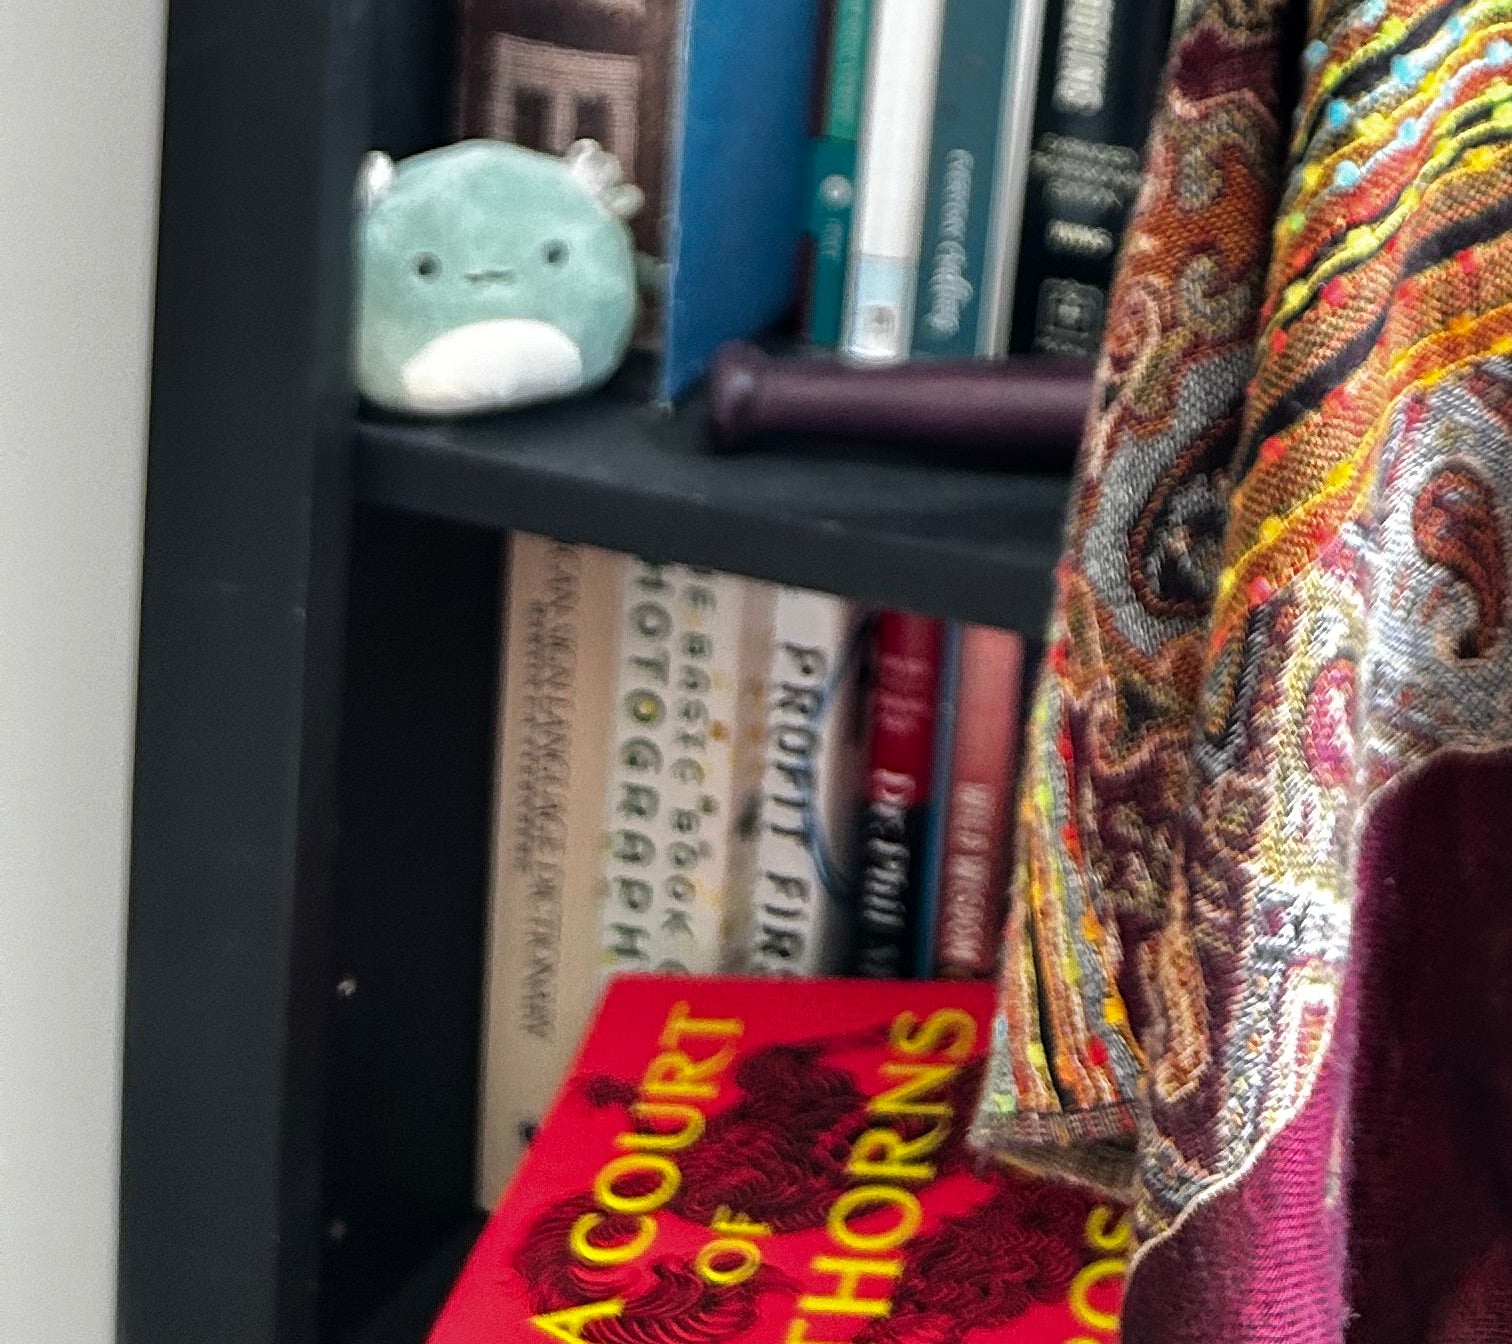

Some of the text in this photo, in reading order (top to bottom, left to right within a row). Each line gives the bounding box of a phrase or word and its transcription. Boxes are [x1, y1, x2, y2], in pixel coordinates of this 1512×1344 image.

[532, 696, 574, 856] LANGUAGE
[608, 562, 674, 965] HOTOGRAPH
[754, 640, 830, 974] PROFIT FIR
[520, 859, 564, 1038] DICTIONARY
[659, 807, 712, 944] BOOK
[862, 835, 911, 927] Phil
[528, 1001, 746, 1344] A COURT
[695, 1208, 772, 1286] OF
